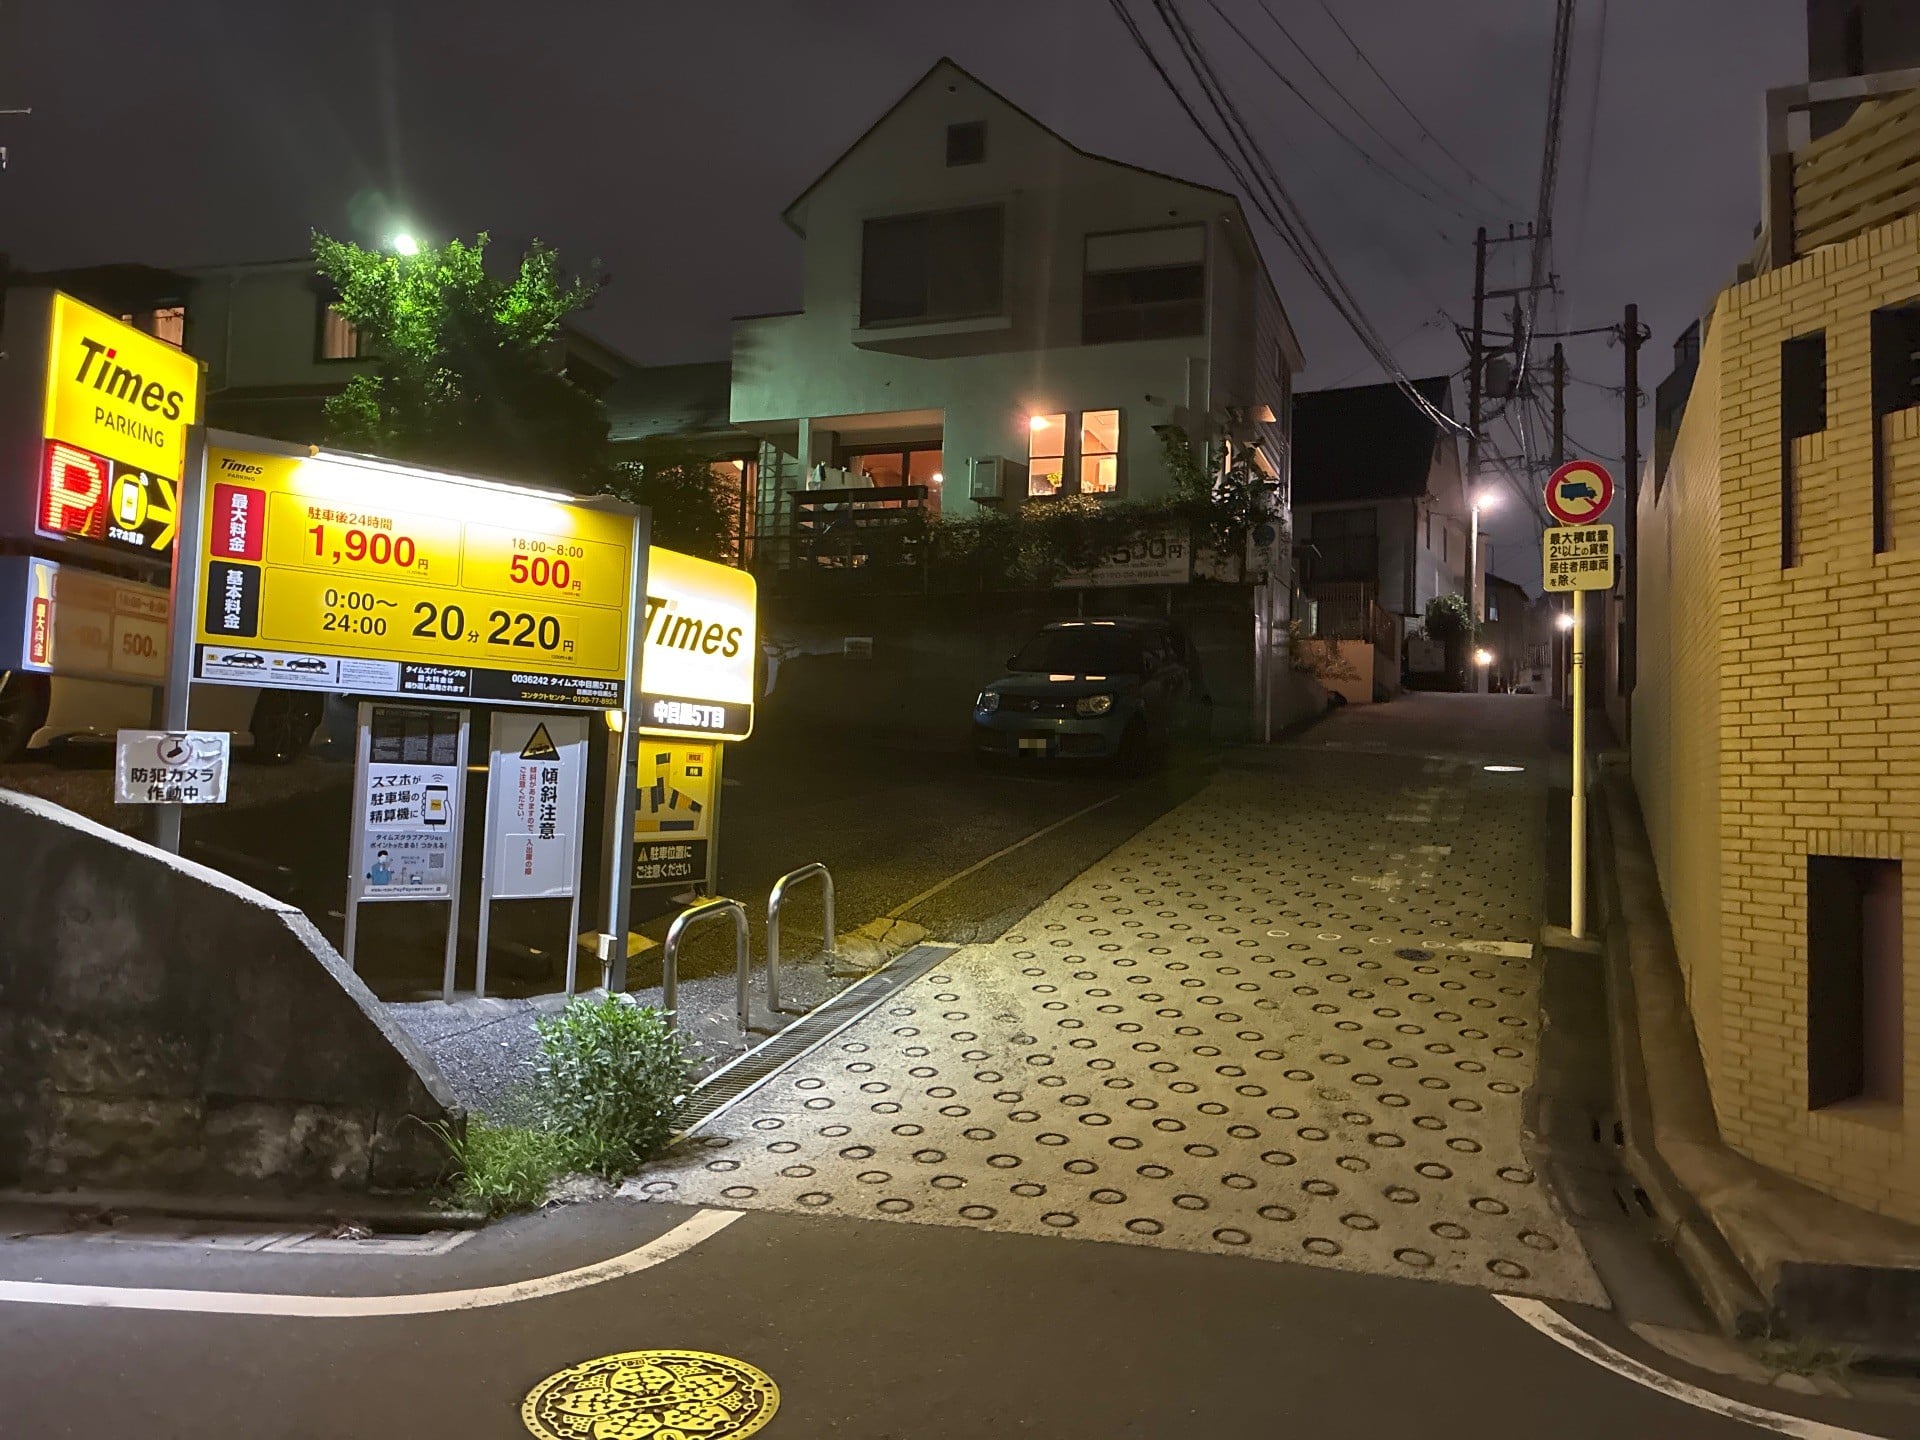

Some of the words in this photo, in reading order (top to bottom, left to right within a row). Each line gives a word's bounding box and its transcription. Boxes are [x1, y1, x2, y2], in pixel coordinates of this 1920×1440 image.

[75, 337, 183, 421] Times
[94, 407, 164, 448] PARKING
[219, 457, 263, 476] Times
[227, 473, 256, 483] PARKING
[49, 445, 101, 530] P
[227, 493, 249, 554] 最大料金
[308, 506, 392, 531] 駐車後24時間
[1550, 529, 1608, 545] 最大積載量
[1550, 543, 1608, 558] 2t以上の貨物
[1550, 559, 1608, 574] 居住者用車両
[1550, 574, 1577, 587] を除く
[223, 569, 244, 630] 基本料金
[323, 611, 388, 637] 24:00
[644, 597, 742, 658] Times
[405, 665, 467, 679] タイムズパーキングの
[511, 673, 548, 687] 0036242
[130, 766, 214, 784] 防犯カメラ
[372, 774, 421, 788] スマホが
[147, 784, 200, 802] 作動中
[371, 790, 420, 807] 駐車場の
[539, 767, 559, 840] 傾斜注意
[370, 807, 418, 824] 精算機に
[650, 845, 692, 861] 駐車位置に
[636, 863, 691, 879] ご注意ください
